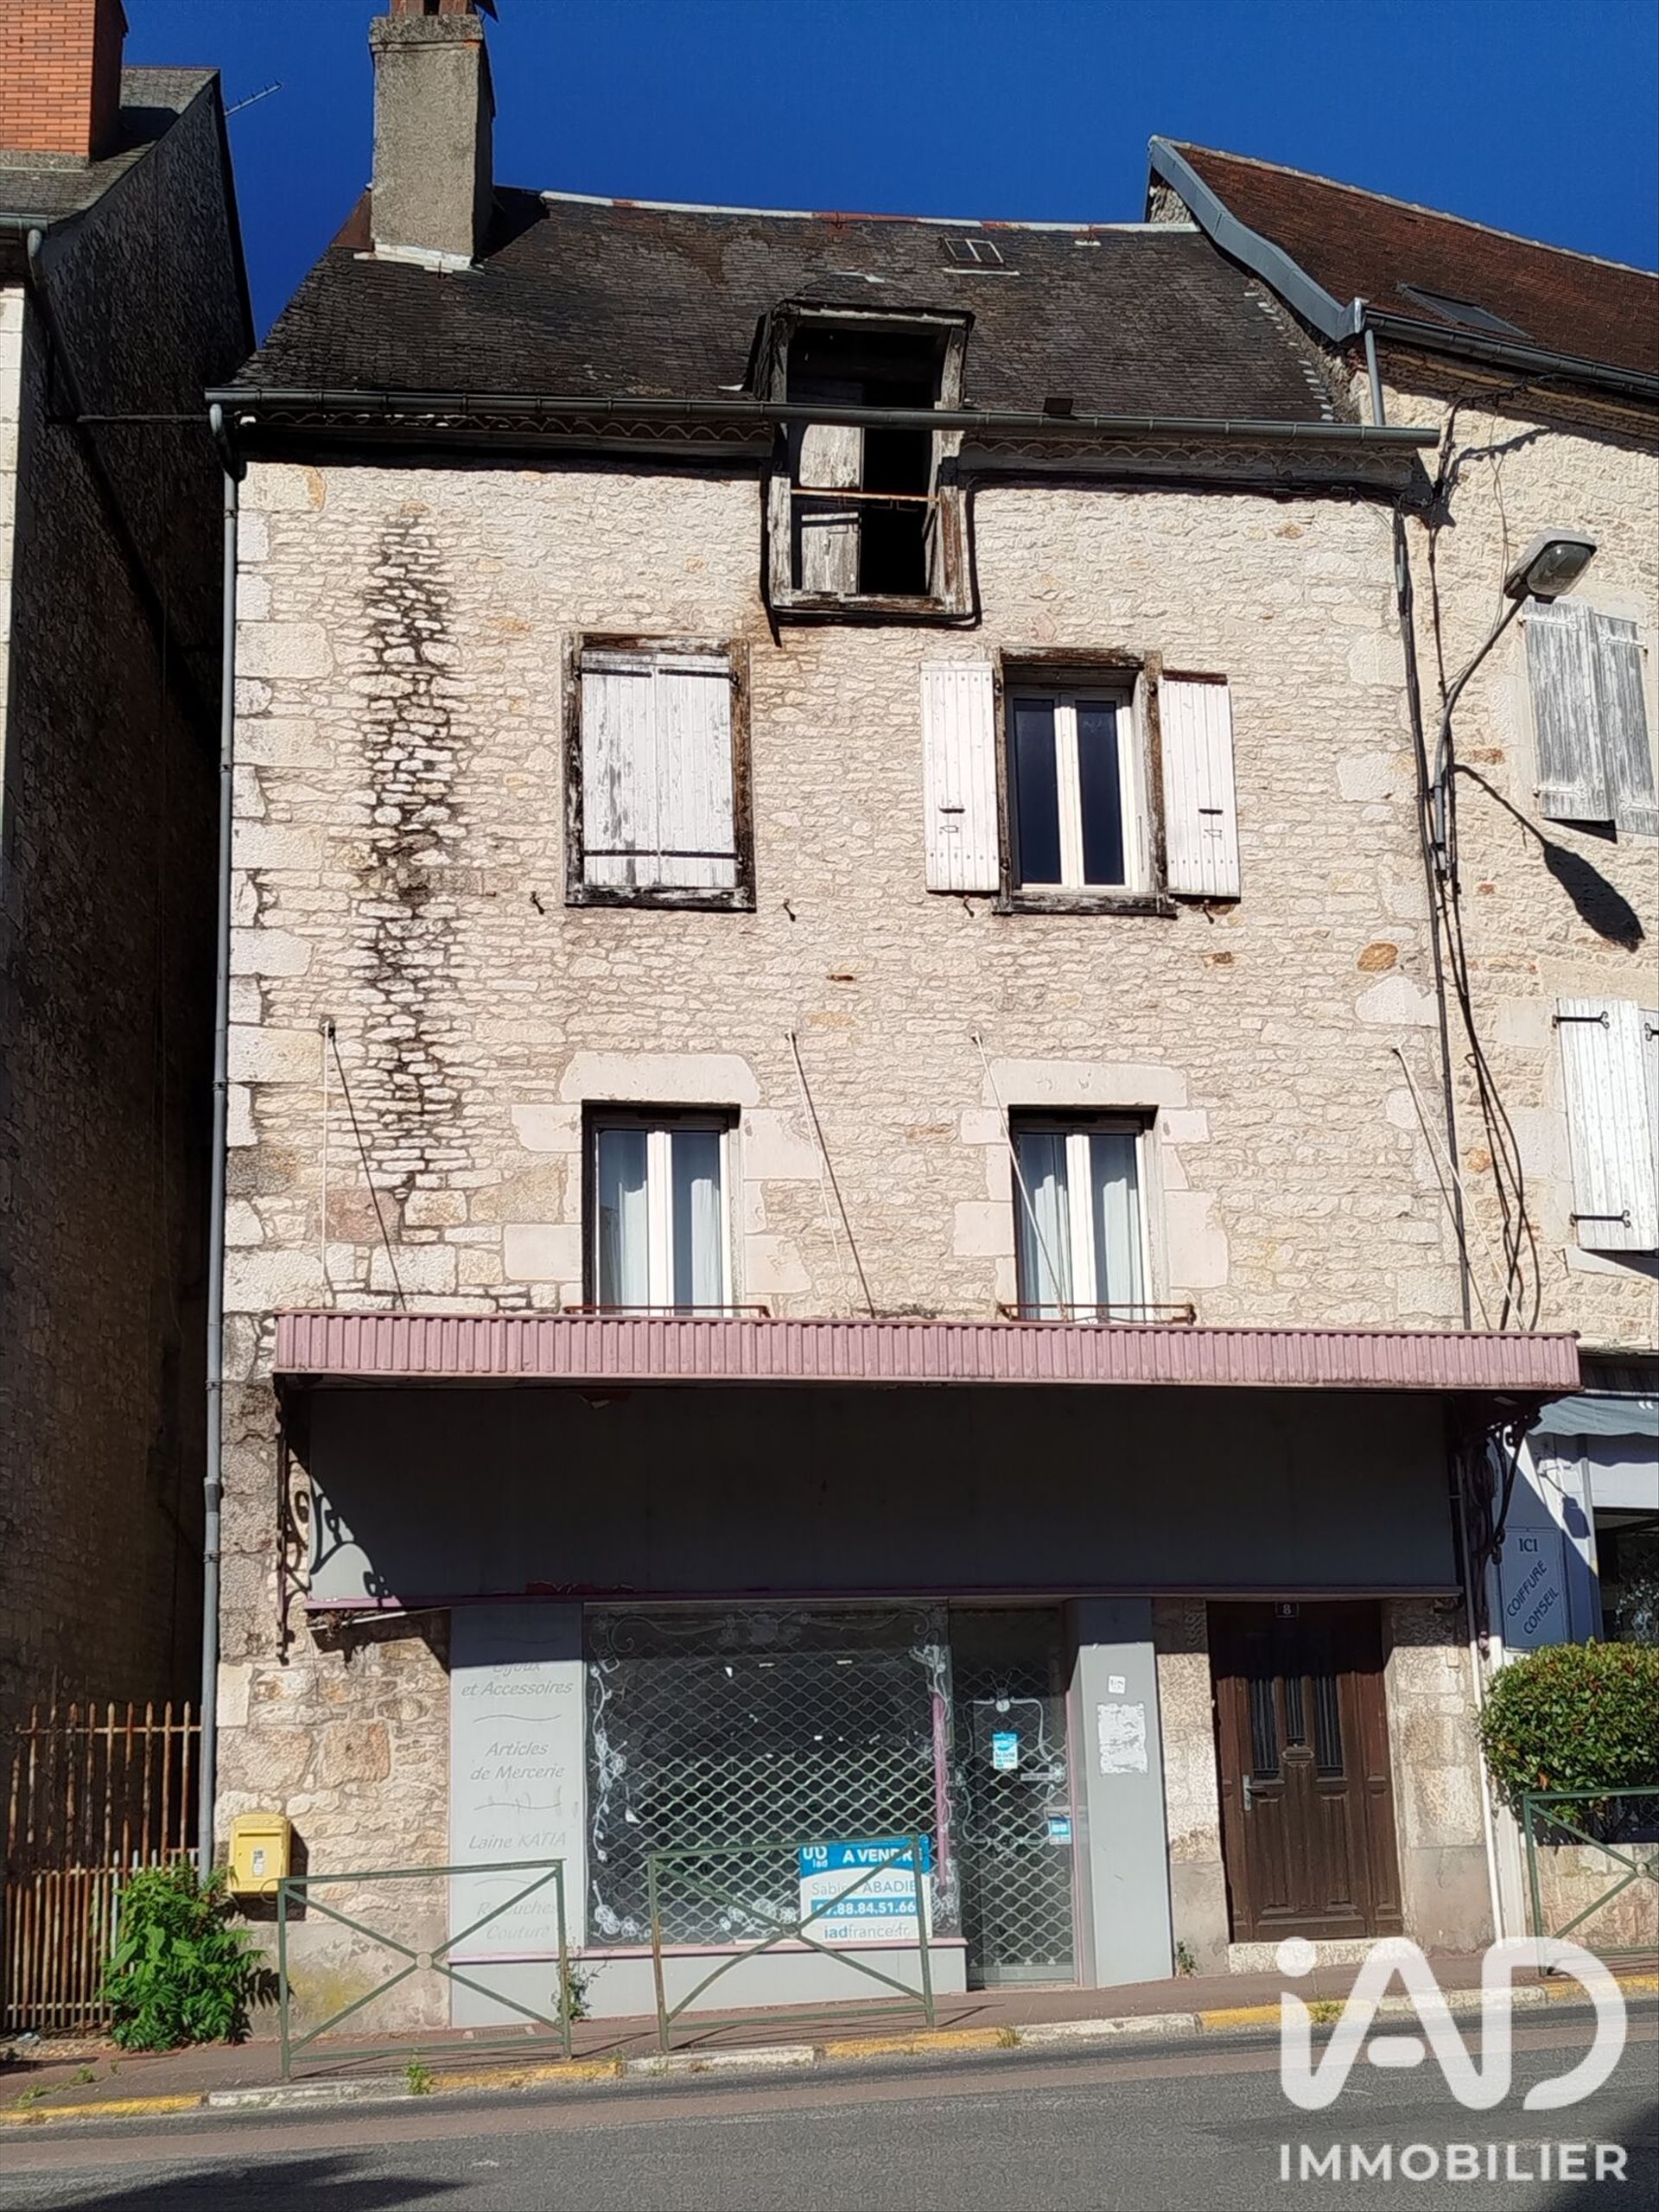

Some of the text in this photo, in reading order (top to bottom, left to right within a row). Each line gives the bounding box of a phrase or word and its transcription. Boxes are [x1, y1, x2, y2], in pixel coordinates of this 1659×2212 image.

[1518, 1538, 1538, 1553] ICI
[1507, 1560, 1548, 1617] COIFFURE
[1282, 1603, 1292, 1615] 8
[1523, 1586, 1560, 1635] CONSEIL
[461, 1680, 574, 1696] et Accessoires
[485, 1741, 549, 1758] Articles
[470, 1764, 565, 1781] de Mercerie
[468, 1831, 568, 1850] Laine KATIA
[842, 1849, 855, 1864] A
[856, 1847, 923, 1863] VENR
[811, 1879, 916, 1896] Sabin ABADIE
[817, 1901, 917, 1916] 7.88.84.51.66
[824, 1923, 910, 1939] iadfrance.fr
